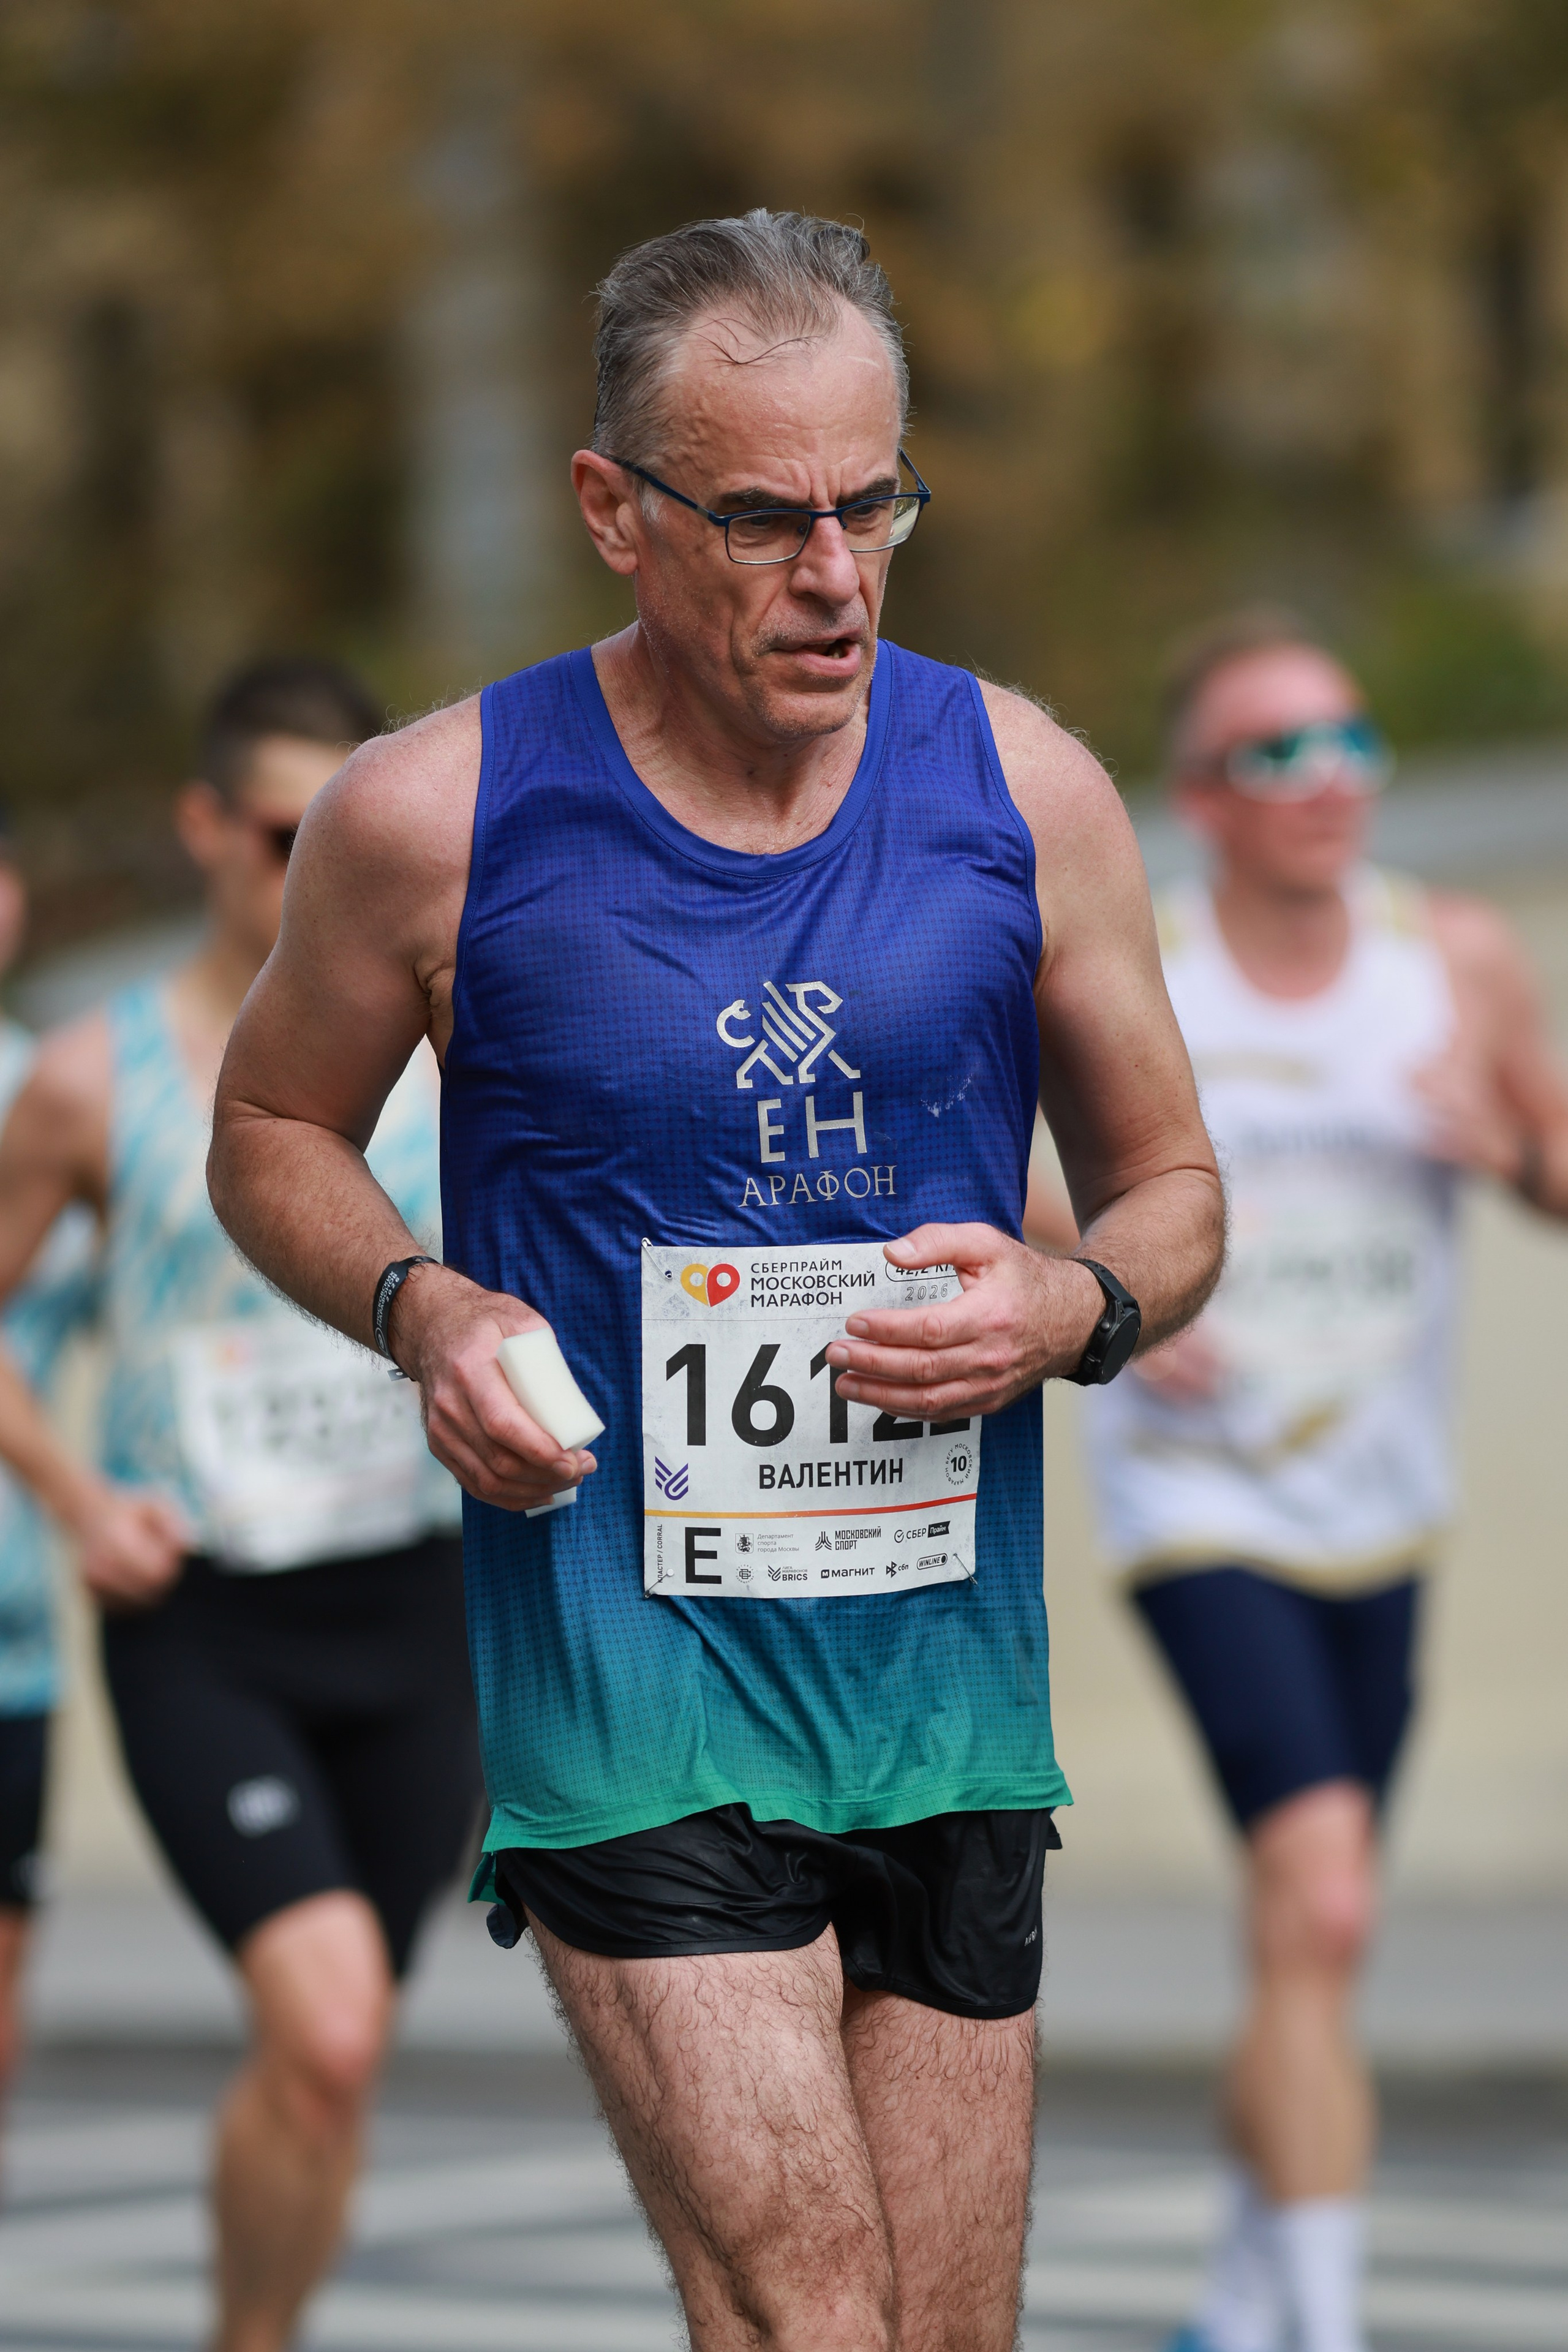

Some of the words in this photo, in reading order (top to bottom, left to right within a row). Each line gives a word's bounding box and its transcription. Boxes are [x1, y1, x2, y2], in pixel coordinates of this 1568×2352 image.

[737, 1165, 897, 1207] АРАФОН
[751, 1258, 842, 1273] СБЕРПРАЙМ
[751, 1270, 875, 1291] МОСКОВСКИЙ
[751, 1292, 842, 1308] МАРАФОН
[905, 1283, 948, 1301] 2026
[666, 1341, 970, 1447] 161
[951, 1455, 967, 1472] 10
[759, 1458, 903, 1489] ВАЛЕНТИН
[835, 1526, 881, 1540] МОСКОВСКИЙ
[907, 1528, 927, 1539] СБЕР
[930, 1525, 946, 1534] Прайм
[835, 1540, 858, 1550] СПОРТ
[919, 1556, 941, 1567] WINLINE
[832, 1567, 875, 1577] магнит
